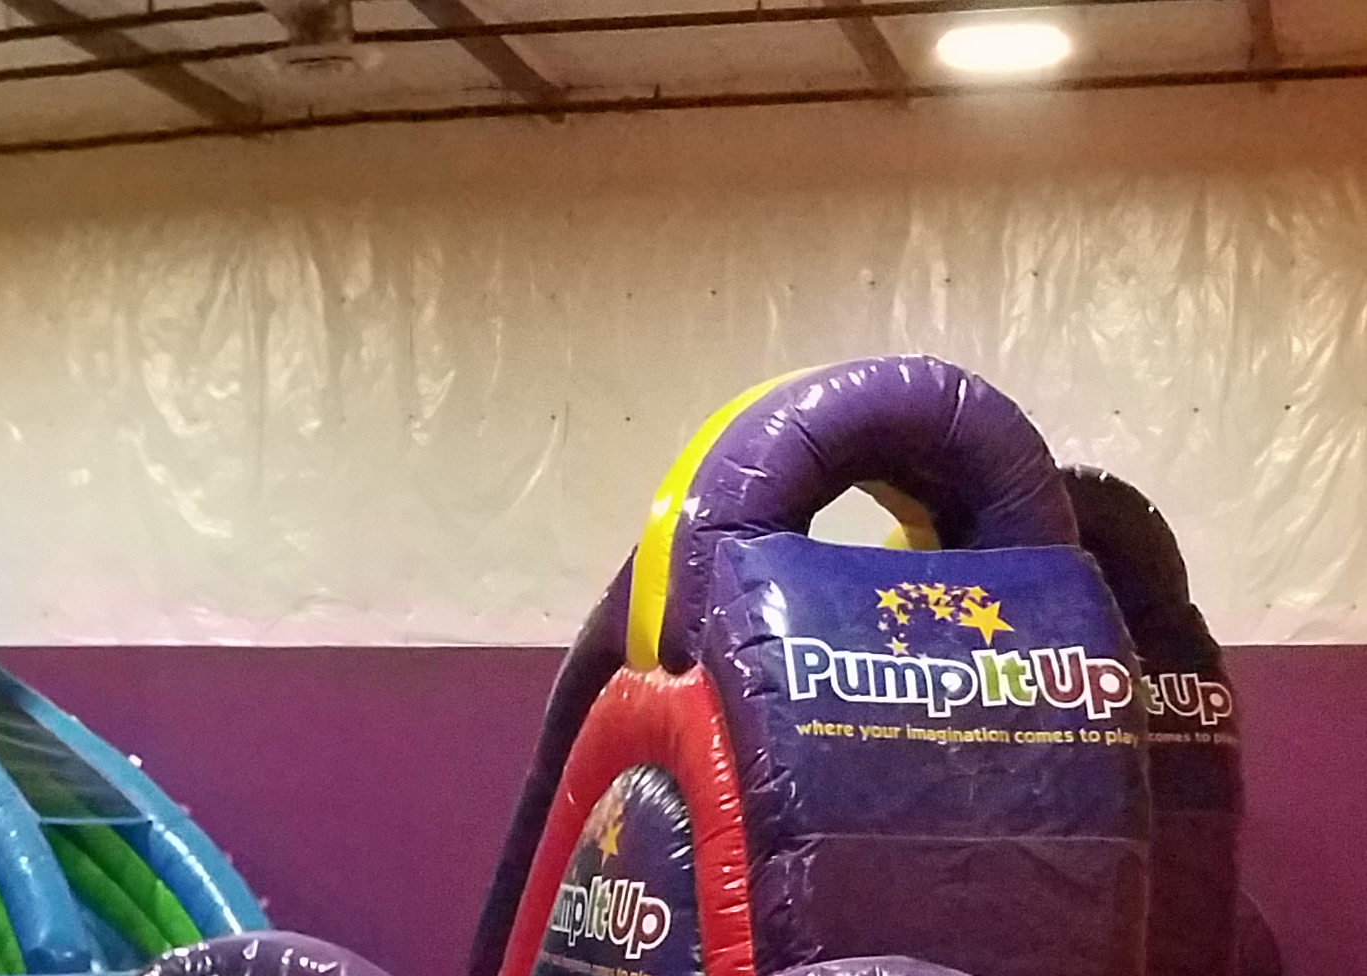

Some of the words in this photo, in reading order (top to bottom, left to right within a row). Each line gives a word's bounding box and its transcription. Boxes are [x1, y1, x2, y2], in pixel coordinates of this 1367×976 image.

[795, 719, 855, 738] where
[859, 724, 902, 742] your
[906, 724, 1011, 745] imagination
[1014, 728, 1075, 744] comes
[1078, 727, 1101, 743] to
